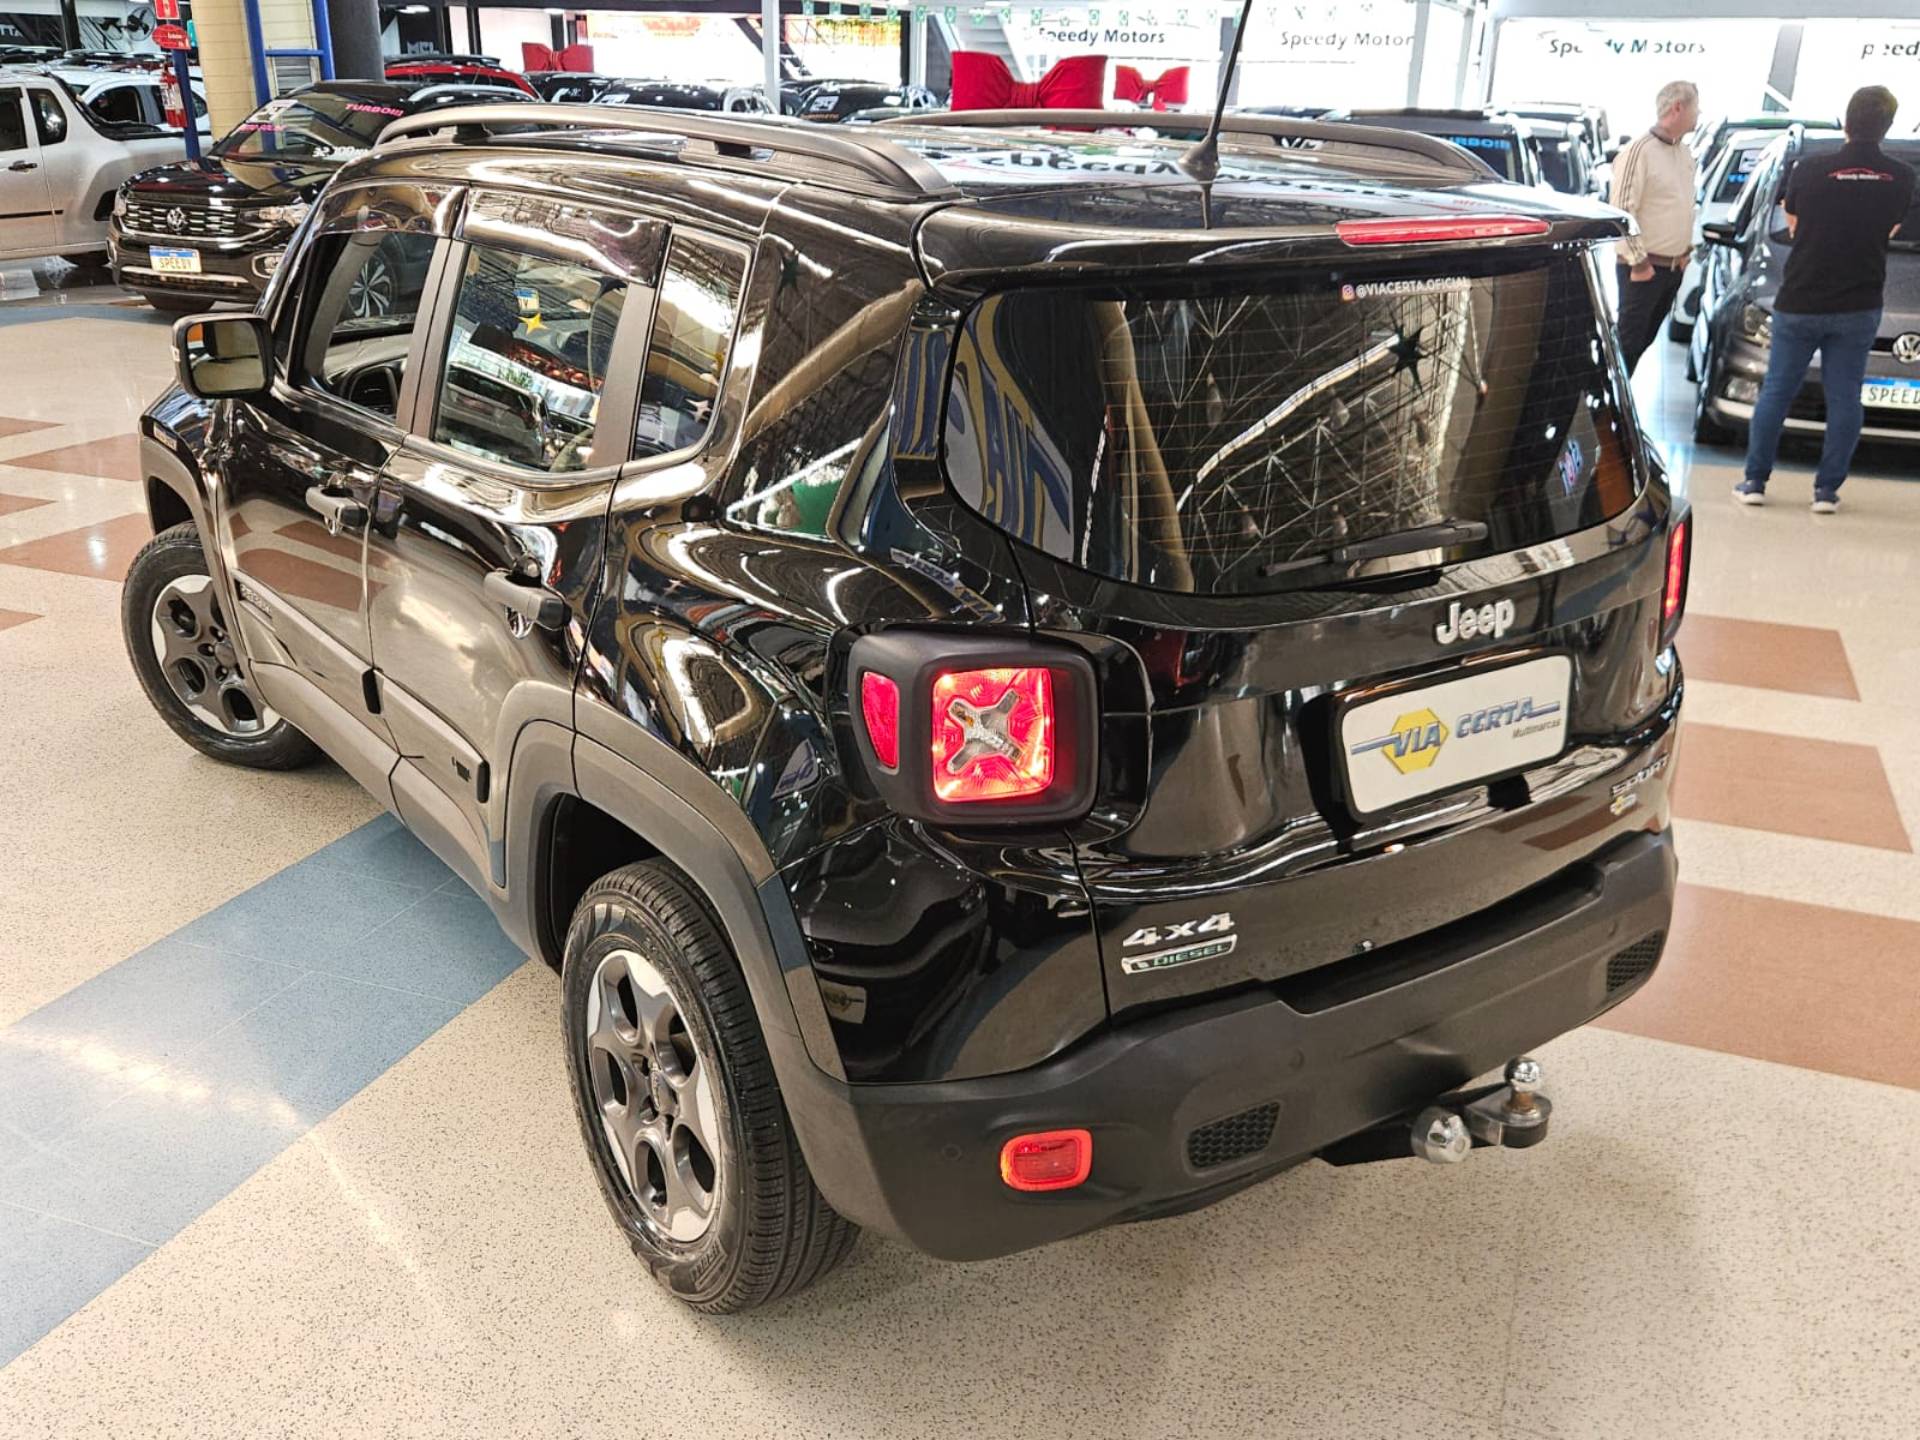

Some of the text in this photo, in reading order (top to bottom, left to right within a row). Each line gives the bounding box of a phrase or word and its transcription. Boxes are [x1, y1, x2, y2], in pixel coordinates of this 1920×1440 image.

[1104, 29, 1166, 43] Motors
[1281, 31, 1416, 50] Speedy Motor
[1549, 38, 1625, 58] Spy
[1435, 598, 1516, 645] Jeep
[1391, 696, 1535, 758] VIA CERTA
[1152, 943, 1230, 968] DIESEL
